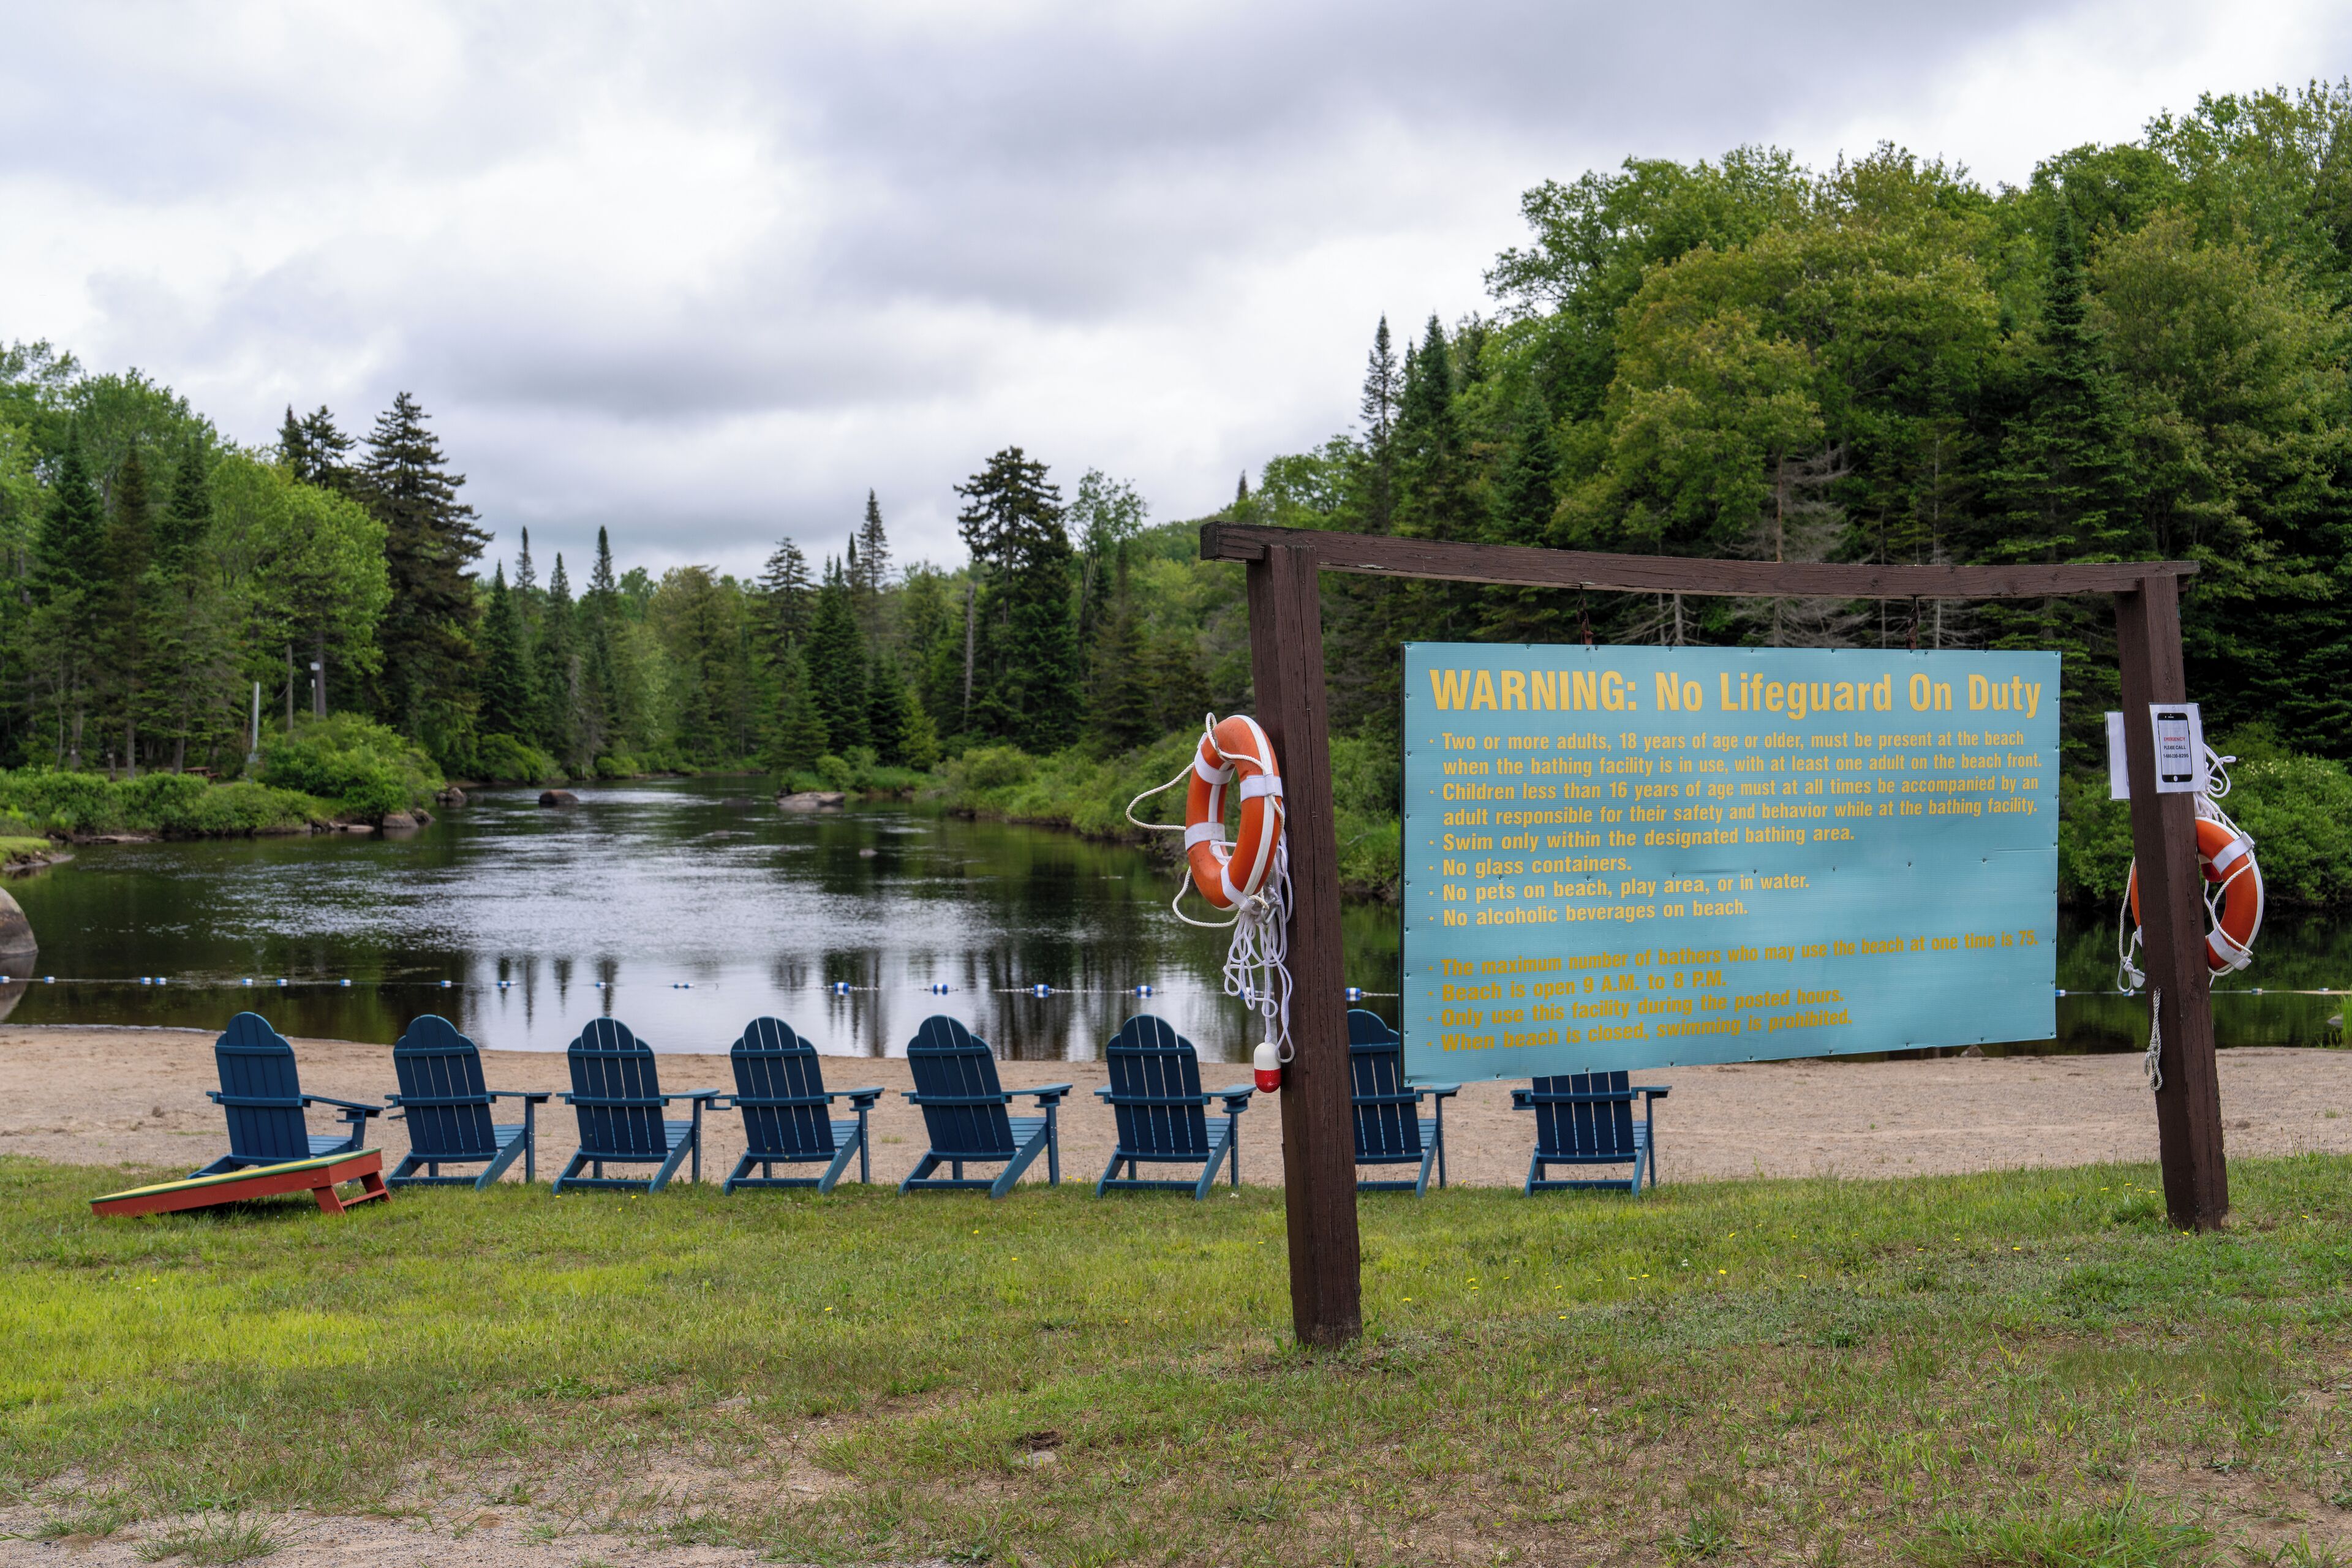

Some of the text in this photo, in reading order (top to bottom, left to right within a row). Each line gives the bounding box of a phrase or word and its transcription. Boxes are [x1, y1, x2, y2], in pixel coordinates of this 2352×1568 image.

[1430, 669, 2041, 720] WARNING: No Lifeguard On Duty
[1442, 730, 2024, 753] Two or more adults, 18 years of age or older, must be present at the beach
[1443, 752, 2041, 777] when the bathing facility is in use, with at least one adult on the beach front.
[1443, 775, 2038, 801] Children less than 16 years of age must at all times be accompanied by an
[1444, 797, 2037, 827] adult responsible for their safety and behavior while at the bathing facility.
[1443, 826, 1854, 853] Swim only within the designated bathing area.
[1443, 855, 1631, 878] No glass containers.
[1443, 873, 1809, 904] No pets on beach, play area, or in water.
[1444, 899, 1747, 926] No alcoholic beverages on beach.
[1441, 930, 2038, 976] The maximum number of bathers who may use the beach at one time is 75.
[1442, 970, 1727, 1001] Beach is open 9 A.M. to 8 P.M.
[1442, 989, 1844, 1028] Only use this facility during the posted hours.
[1441, 1009, 1852, 1051] When beach is closed, swimming is prohibited.
